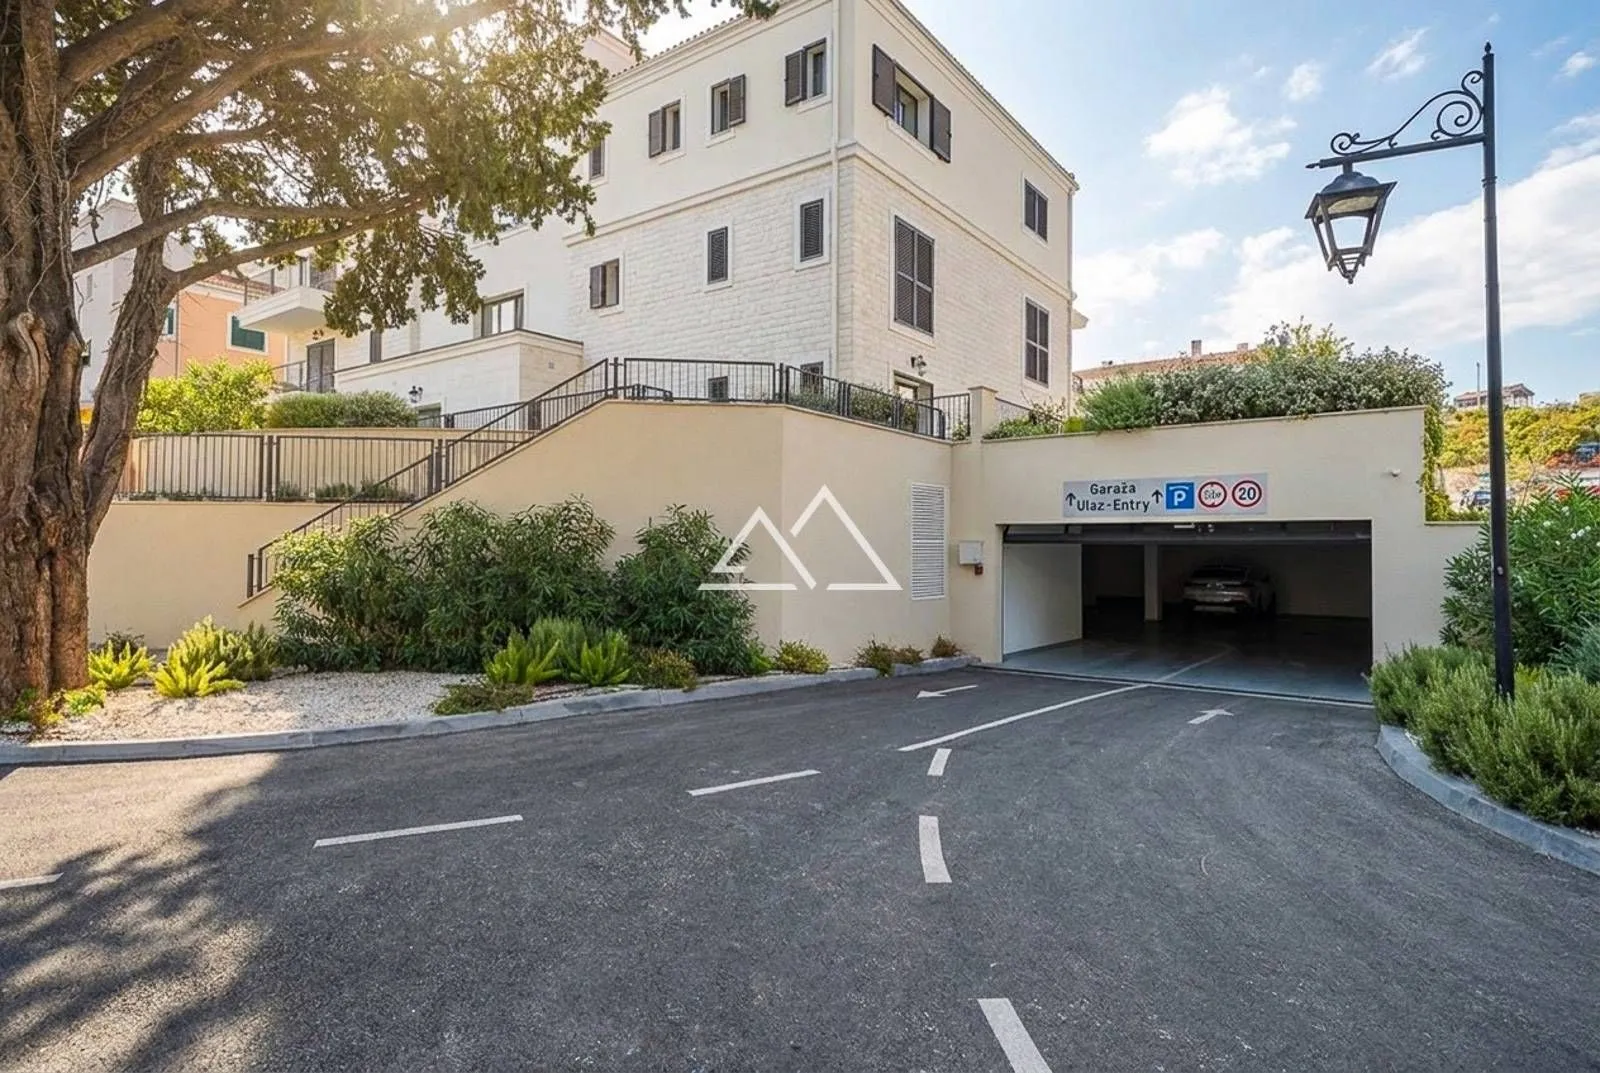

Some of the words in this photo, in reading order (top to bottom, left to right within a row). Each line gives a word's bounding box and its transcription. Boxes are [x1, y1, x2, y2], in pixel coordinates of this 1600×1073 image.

[1174, 490, 1187, 505] P
[1238, 486, 1257, 500] 20
[1077, 499, 1149, 512] Ulaz-Entry
